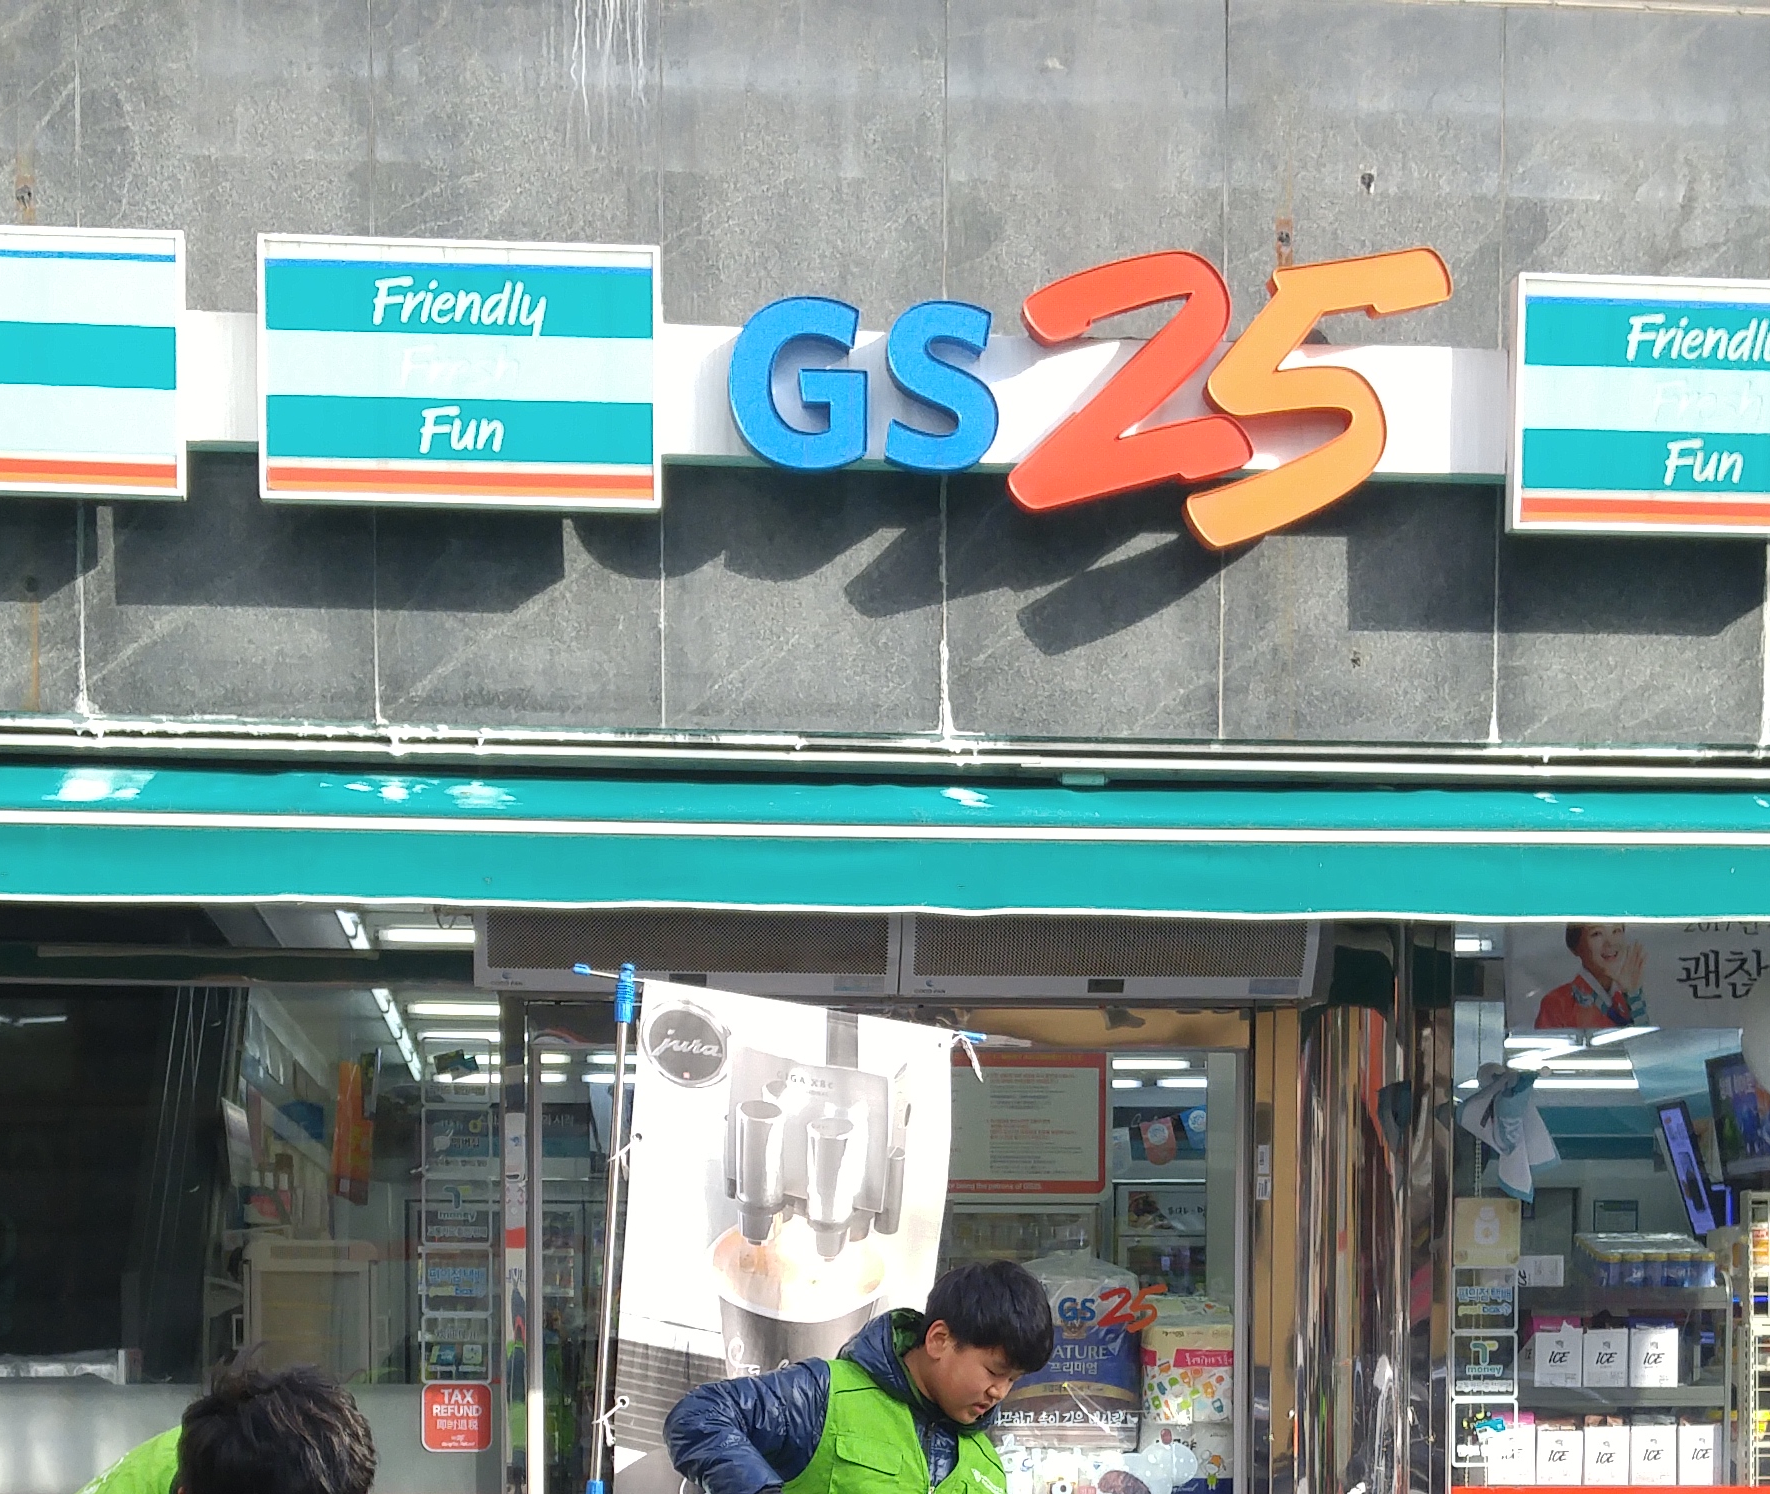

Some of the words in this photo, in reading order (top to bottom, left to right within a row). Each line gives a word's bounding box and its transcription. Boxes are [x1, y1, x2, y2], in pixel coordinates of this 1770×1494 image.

[373, 276, 547, 337] Friendly
[728, 247, 1453, 551] GS25
[417, 405, 506, 454] Fun
[1662, 440, 1743, 488] Fun
[650, 1028, 722, 1058] jura
[1057, 1283, 1168, 1333] GS25
[1051, 1344, 1109, 1360] ATURE
[1548, 1350, 1571, 1364] ICE
[1595, 1351, 1618, 1365] ICE
[1643, 1352, 1665, 1365] ICE
[1048, 1361, 1099, 1376] 프리미엄
[1465, 1364, 1504, 1377] money
[440, 1388, 475, 1404] TAX
[432, 1404, 483, 1418] REFUND
[1548, 1450, 1570, 1463] ICE
[1595, 1451, 1617, 1465] ICE
[1643, 1448, 1665, 1462] ICE
[1691, 1447, 1713, 1461] ICE
